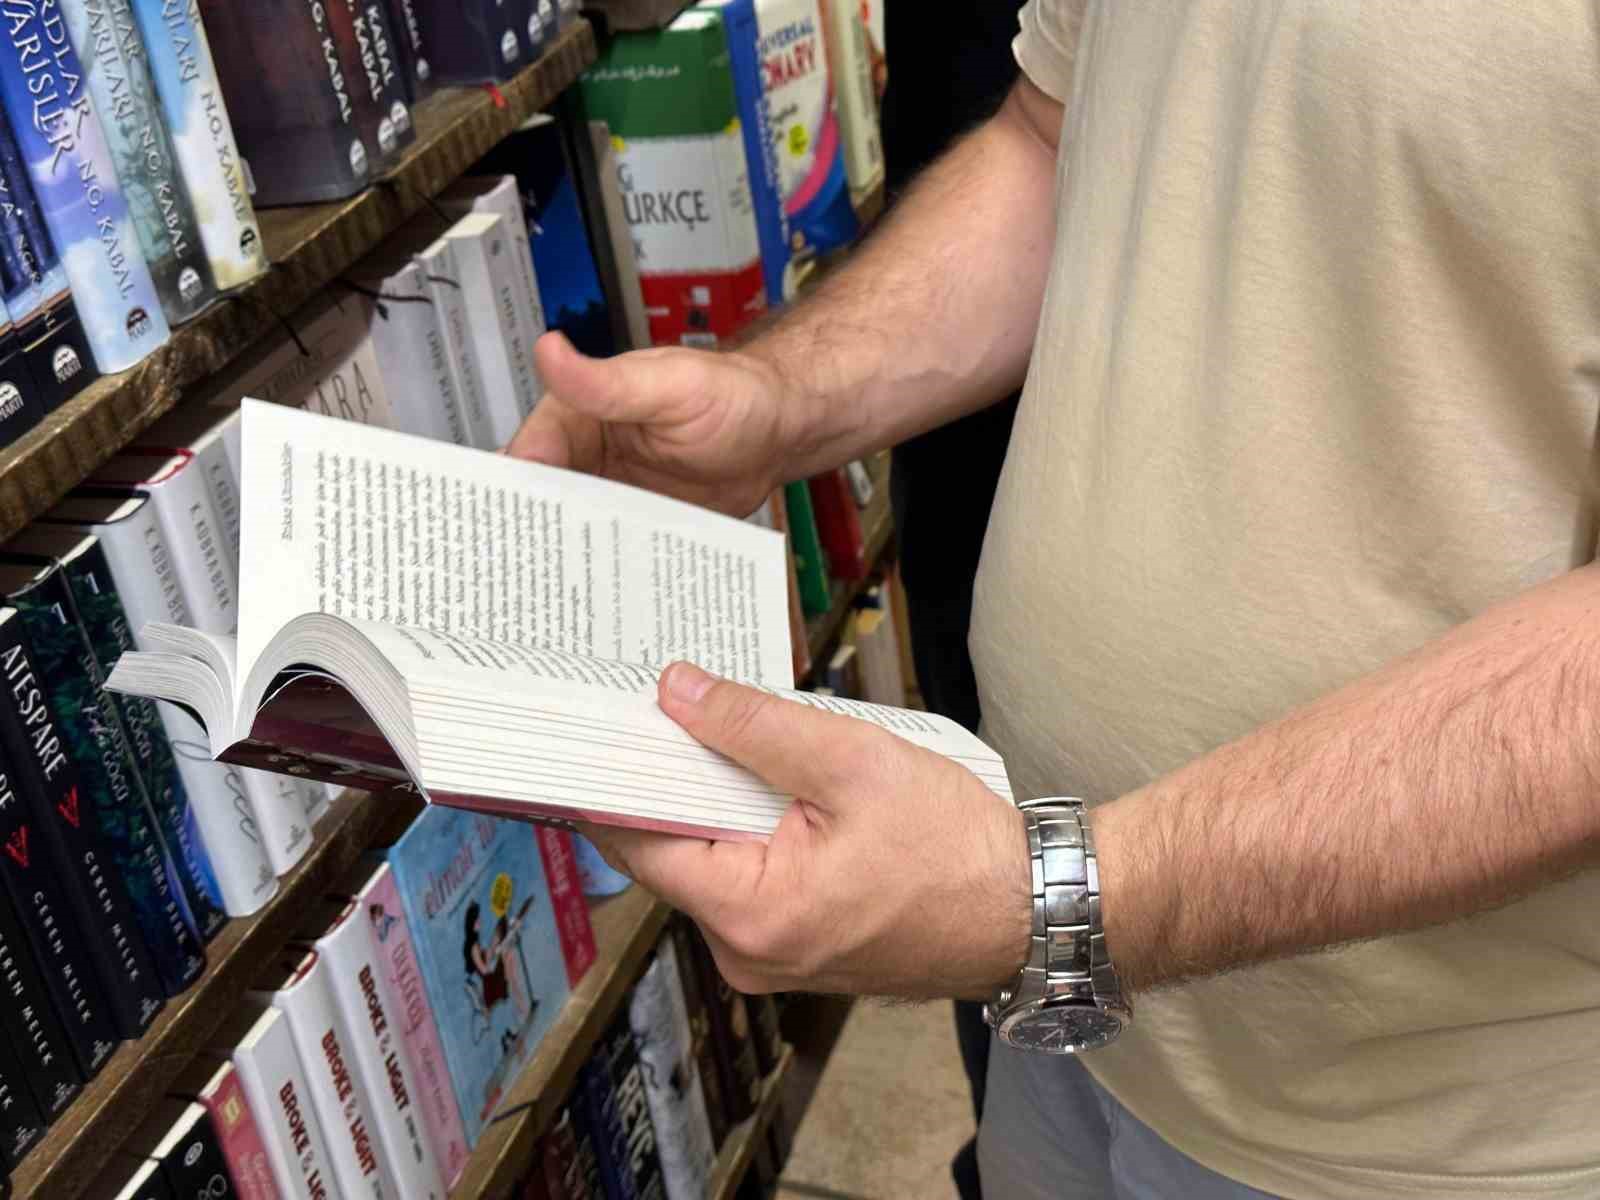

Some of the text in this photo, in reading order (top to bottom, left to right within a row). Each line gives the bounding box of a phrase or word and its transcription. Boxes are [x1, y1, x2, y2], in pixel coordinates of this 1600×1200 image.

[321, 37, 352, 124] KABAL
[353, 15, 382, 102] KABAL
[157, 182, 188, 259] KABAL
[216, 145, 250, 220] KABAL
[97, 215, 136, 300] KABAL
[34, 889, 65, 955] CEREN
[84, 850, 140, 983] CEREN MELEK
[22, 1004, 52, 1067] MELEK
[357, 963, 388, 1037] BROKE
[279, 1079, 310, 1157] BROKE
[321, 1027, 353, 1104] BROKE
[350, 1116, 378, 1177] LIGHT
